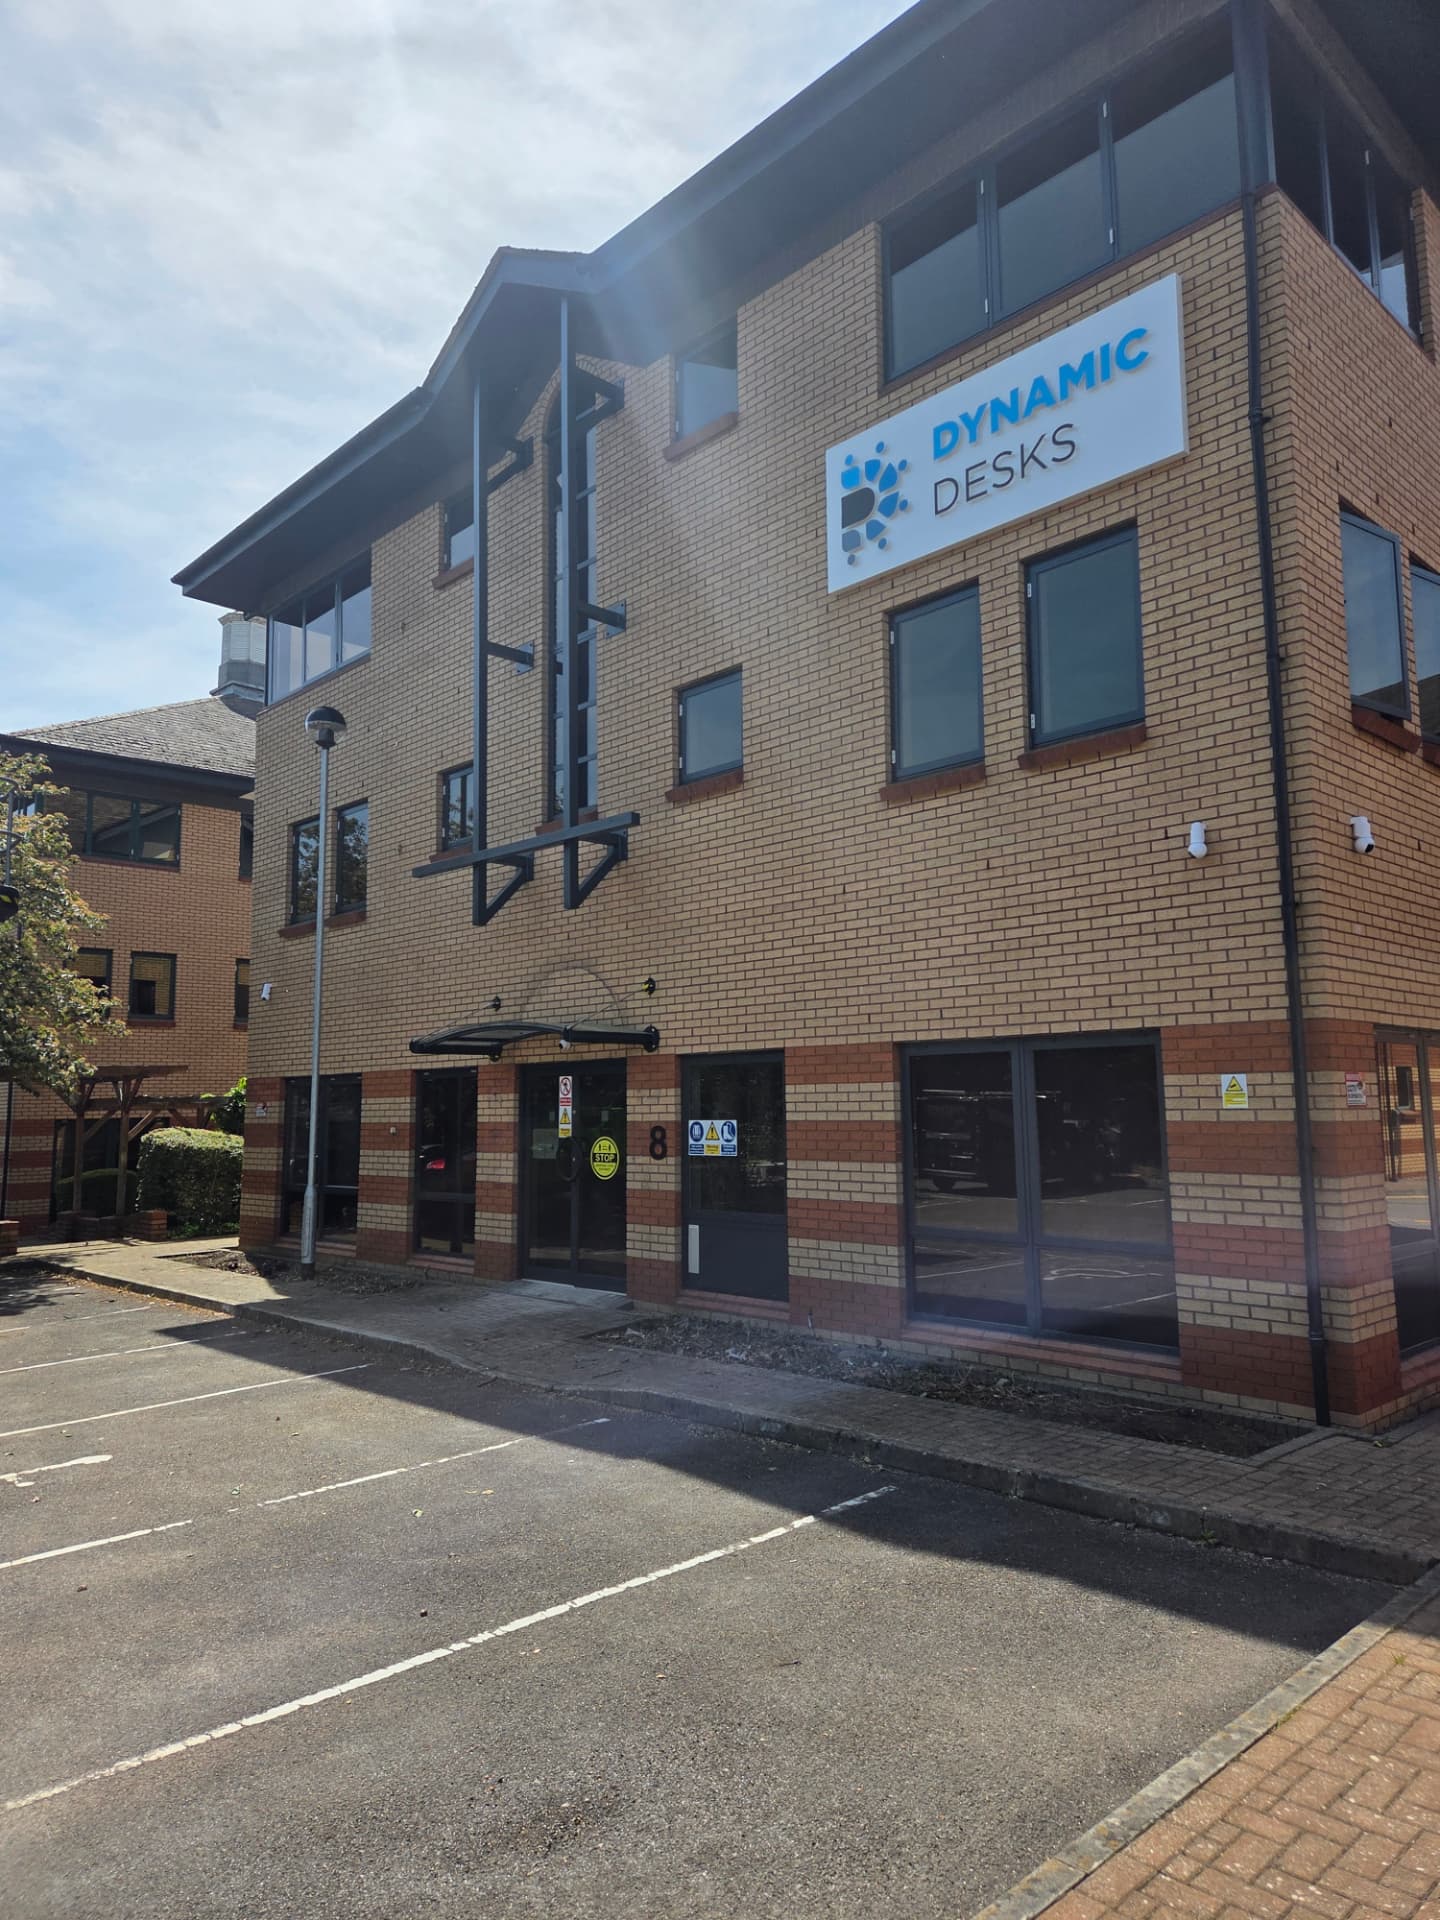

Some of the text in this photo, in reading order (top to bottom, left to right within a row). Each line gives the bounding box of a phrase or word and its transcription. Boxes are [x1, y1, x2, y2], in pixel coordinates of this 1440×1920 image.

[933, 328, 1149, 461] DYNAMIC
[934, 423, 1077, 516] DESKS
[595, 1153, 615, 1162] STOP
[649, 1125, 667, 1160] 8
